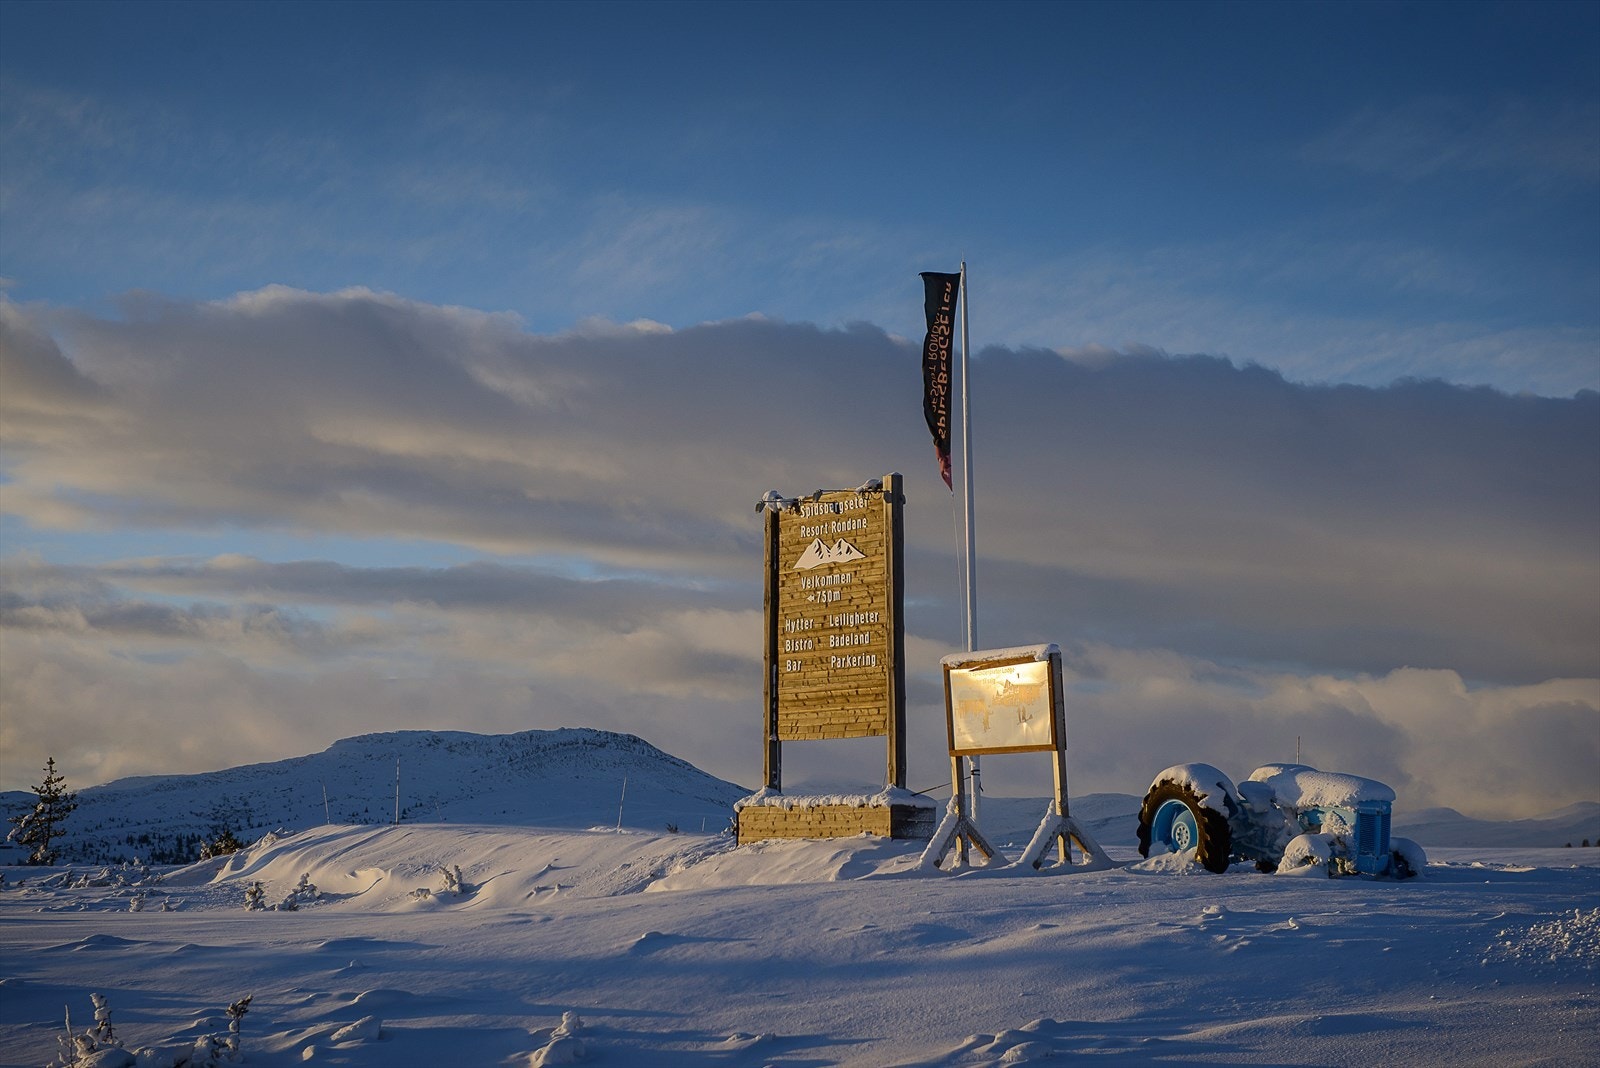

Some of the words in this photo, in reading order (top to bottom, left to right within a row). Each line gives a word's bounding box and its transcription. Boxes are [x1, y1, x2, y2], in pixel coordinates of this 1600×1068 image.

[800, 496, 868, 519] Spidsbergseter
[801, 522, 829, 538] Resort
[831, 517, 867, 534] Rondane
[801, 572, 852, 589] Velkommen
[816, 590, 841, 604] 750m
[785, 618, 814, 633] Hytter
[829, 611, 879, 627] Leiligheter
[785, 639, 813, 652] Bistro
[829, 631, 870, 648] Badeland
[786, 659, 802, 672] Bar
[831, 653, 876, 668] Parkering
